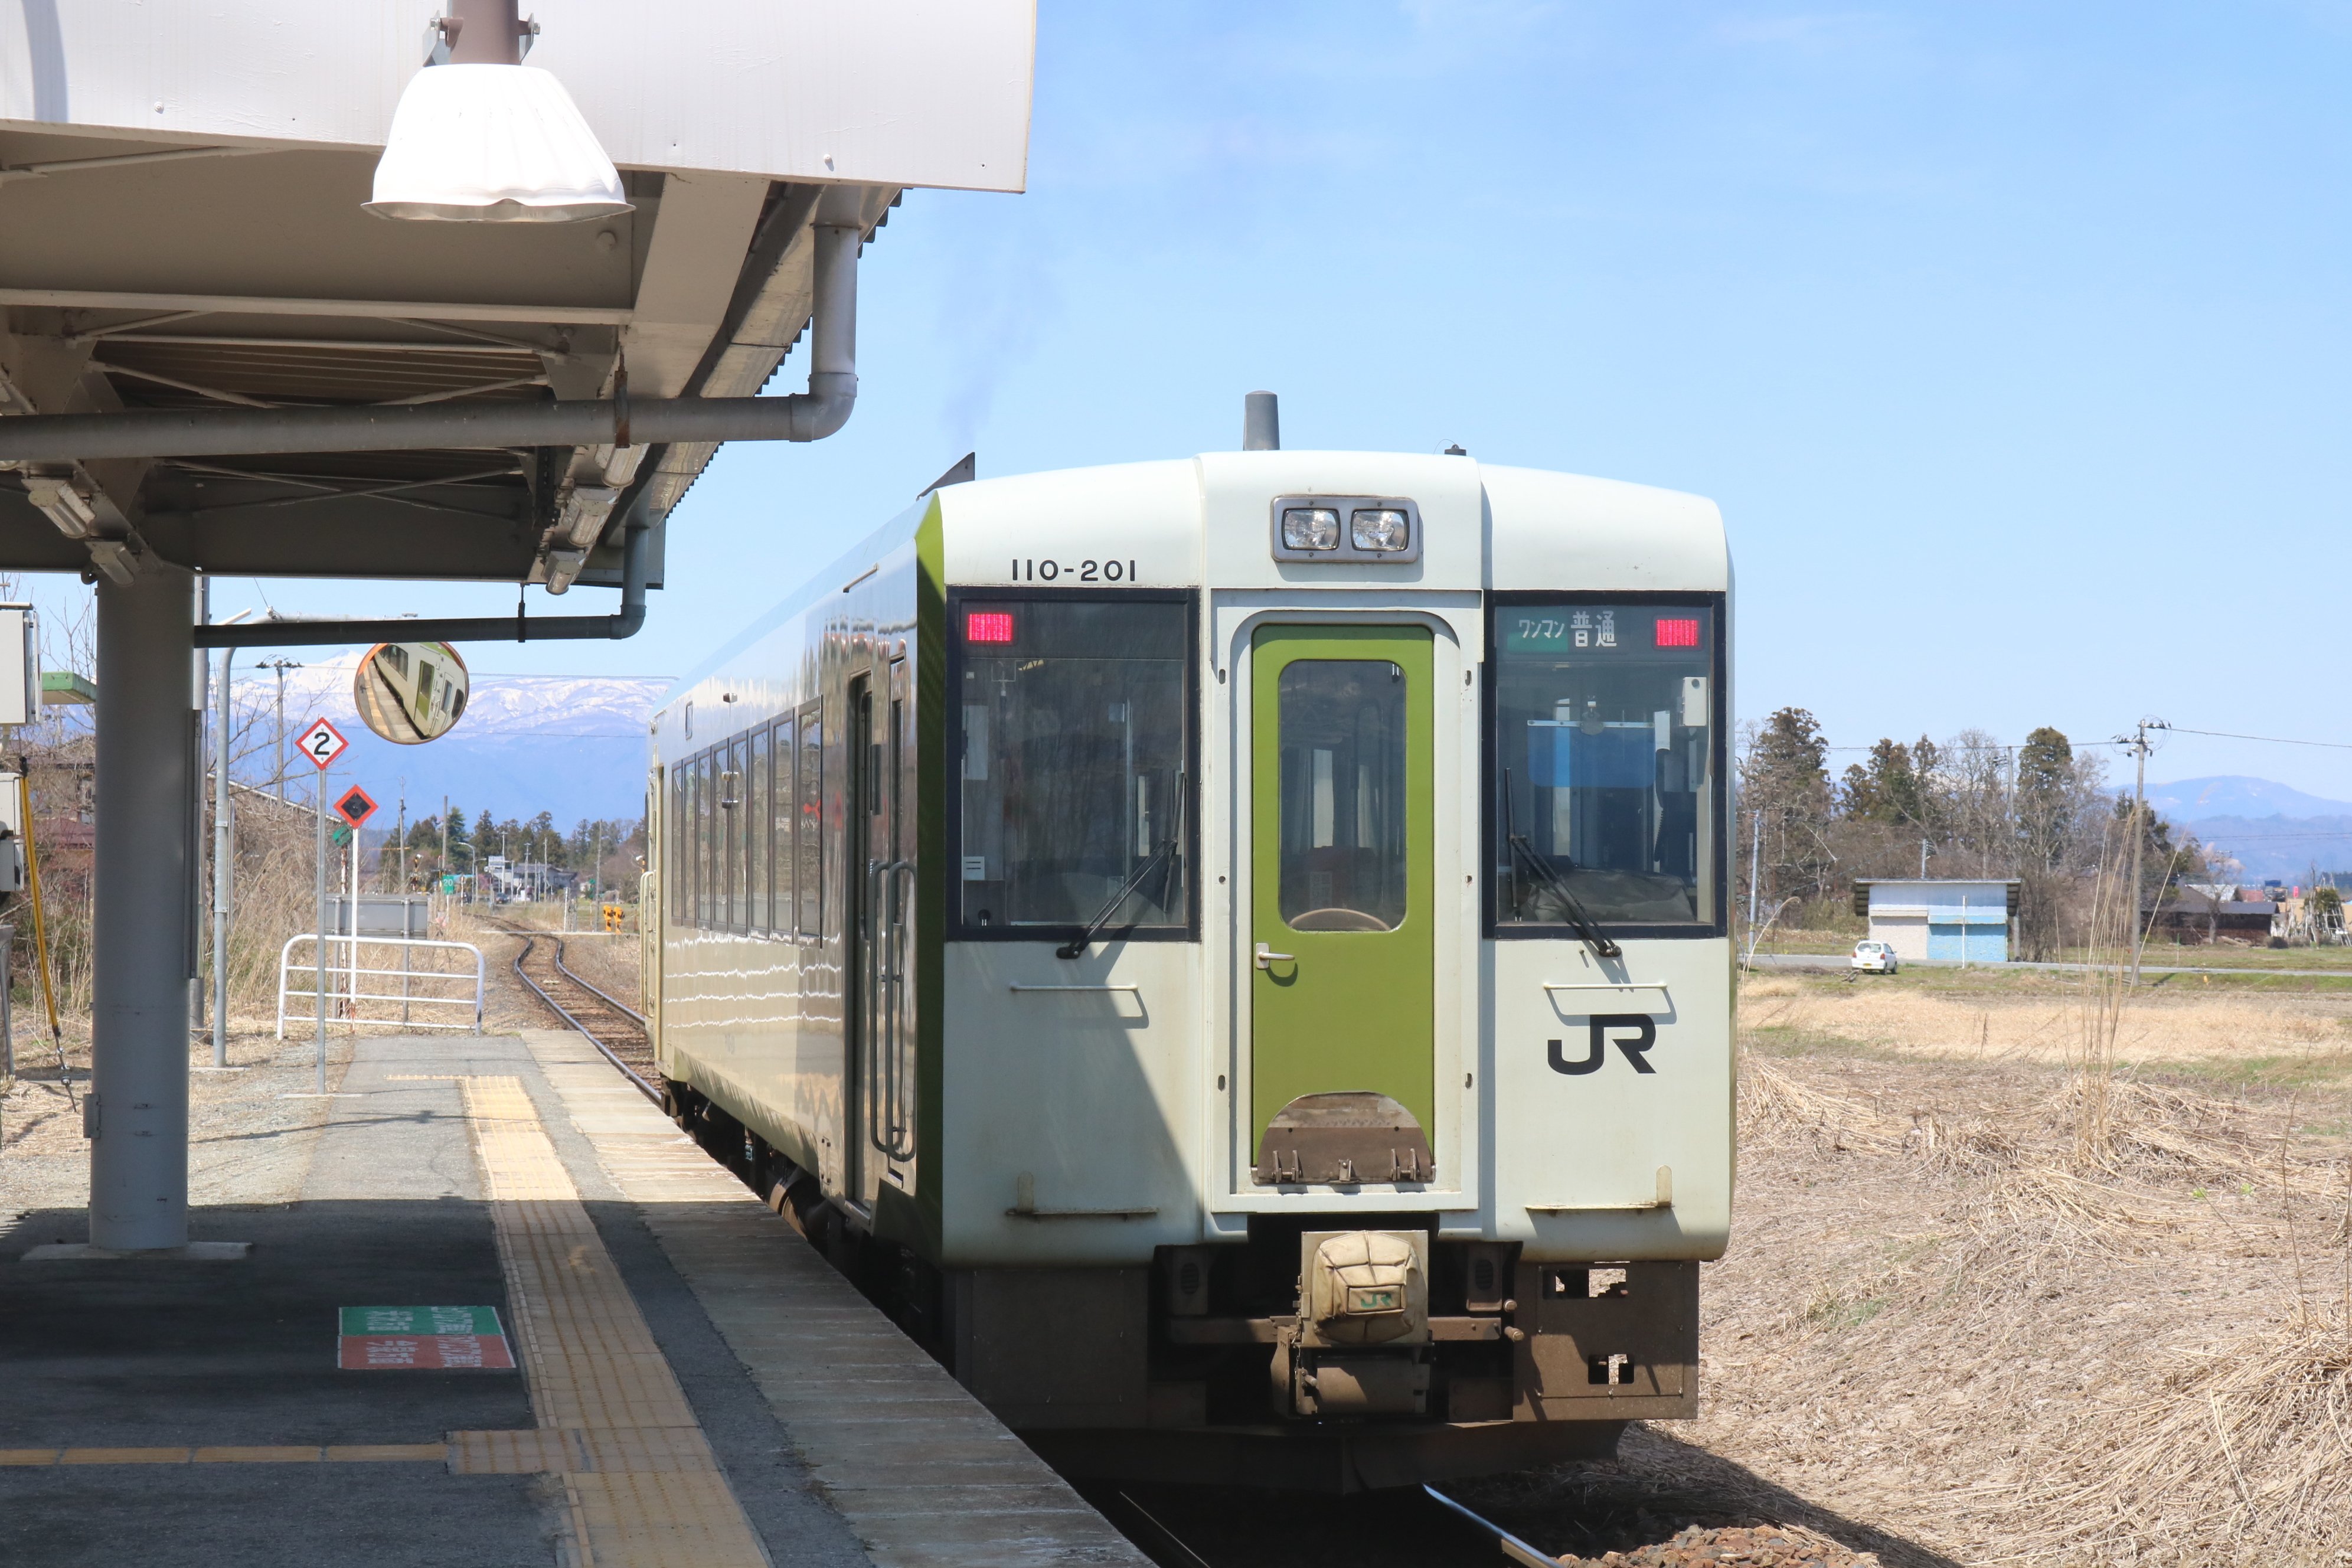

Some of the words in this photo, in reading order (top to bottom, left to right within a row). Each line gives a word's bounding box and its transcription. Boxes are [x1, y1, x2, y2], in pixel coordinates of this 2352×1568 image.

[1012, 559, 1135, 582] 110-201
[1519, 619, 1565, 638] ワンマン
[1570, 610, 1617, 647] 普通
[313, 732, 330, 755] 2
[1547, 1014, 1657, 1075] JR
[1360, 1292, 1393, 1308] JR
